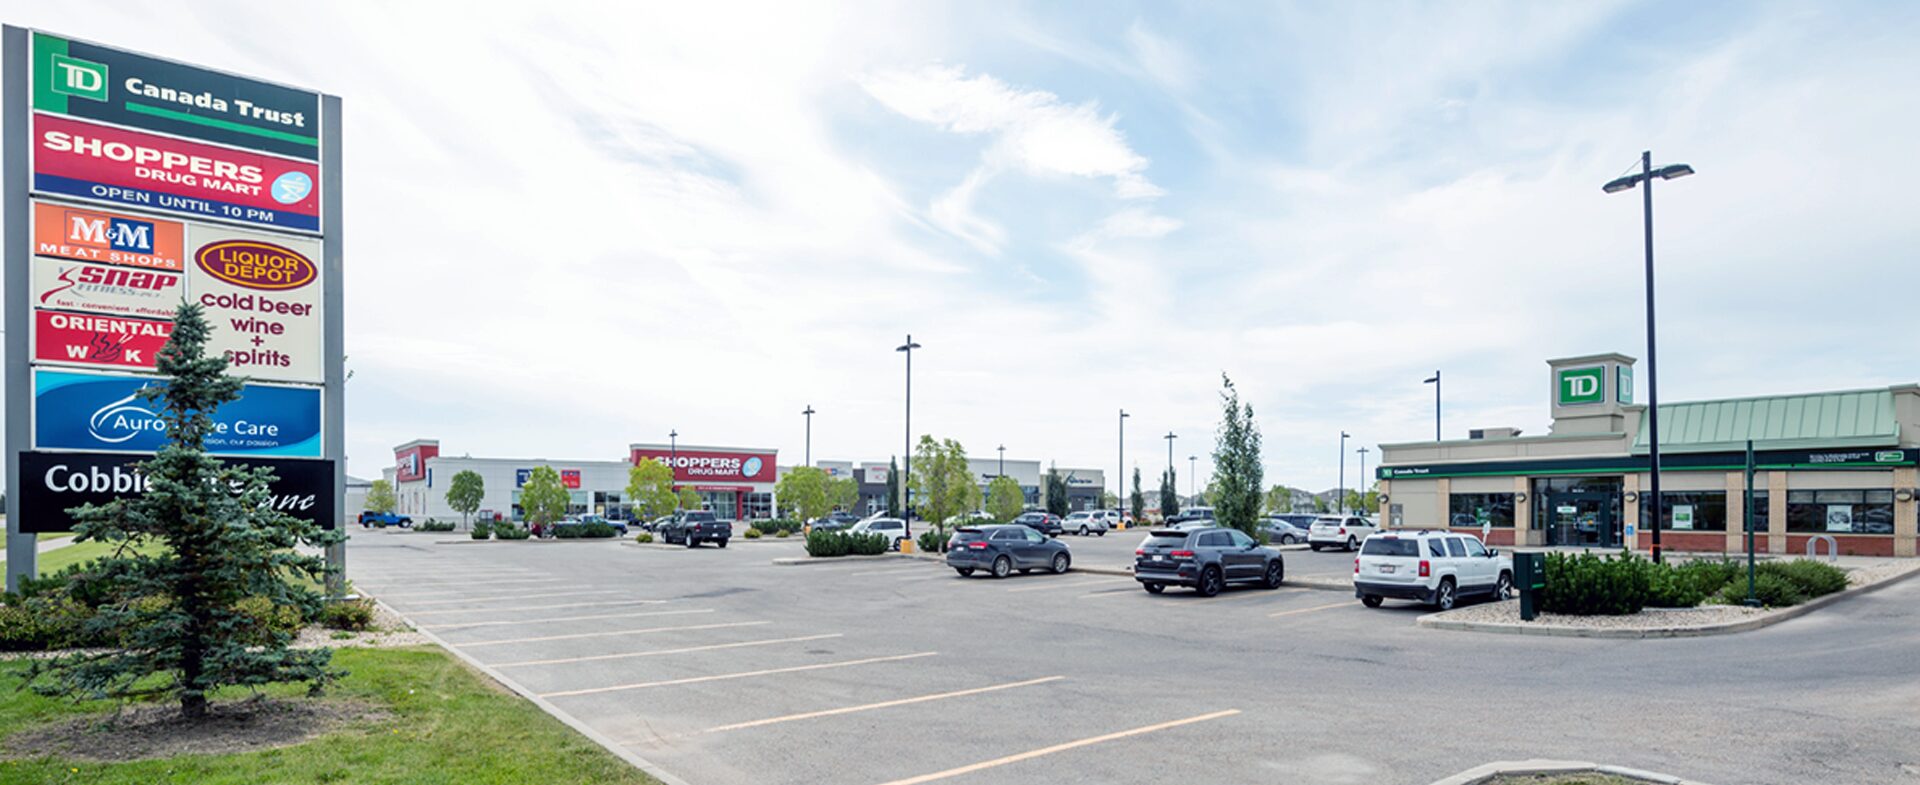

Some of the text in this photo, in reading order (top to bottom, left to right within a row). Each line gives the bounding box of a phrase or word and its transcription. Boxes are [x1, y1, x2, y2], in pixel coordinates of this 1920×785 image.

[58, 63, 306, 128] TD Canada Trust
[43, 131, 264, 185] SHOPPERS
[135, 166, 263, 197] DRUG MART
[91, 184, 275, 223] OPEN UNTIL 10 PM
[70, 216, 151, 250] M&M
[40, 242, 177, 269] MEAT SHOPS
[219, 249, 299, 273] LIQUOR
[78, 266, 178, 292] snap
[224, 263, 296, 284] DEPOT
[56, 299, 74, 308] fast
[82, 302, 131, 313] convenient
[201, 292, 313, 318] cold beer
[50, 314, 171, 338] ORIENTAL
[231, 315, 285, 336] wine
[224, 348, 291, 368] spirits
[1563, 375, 1599, 397] TD
[234, 420, 279, 437] Care
[656, 456, 741, 469] SHOPPERS
